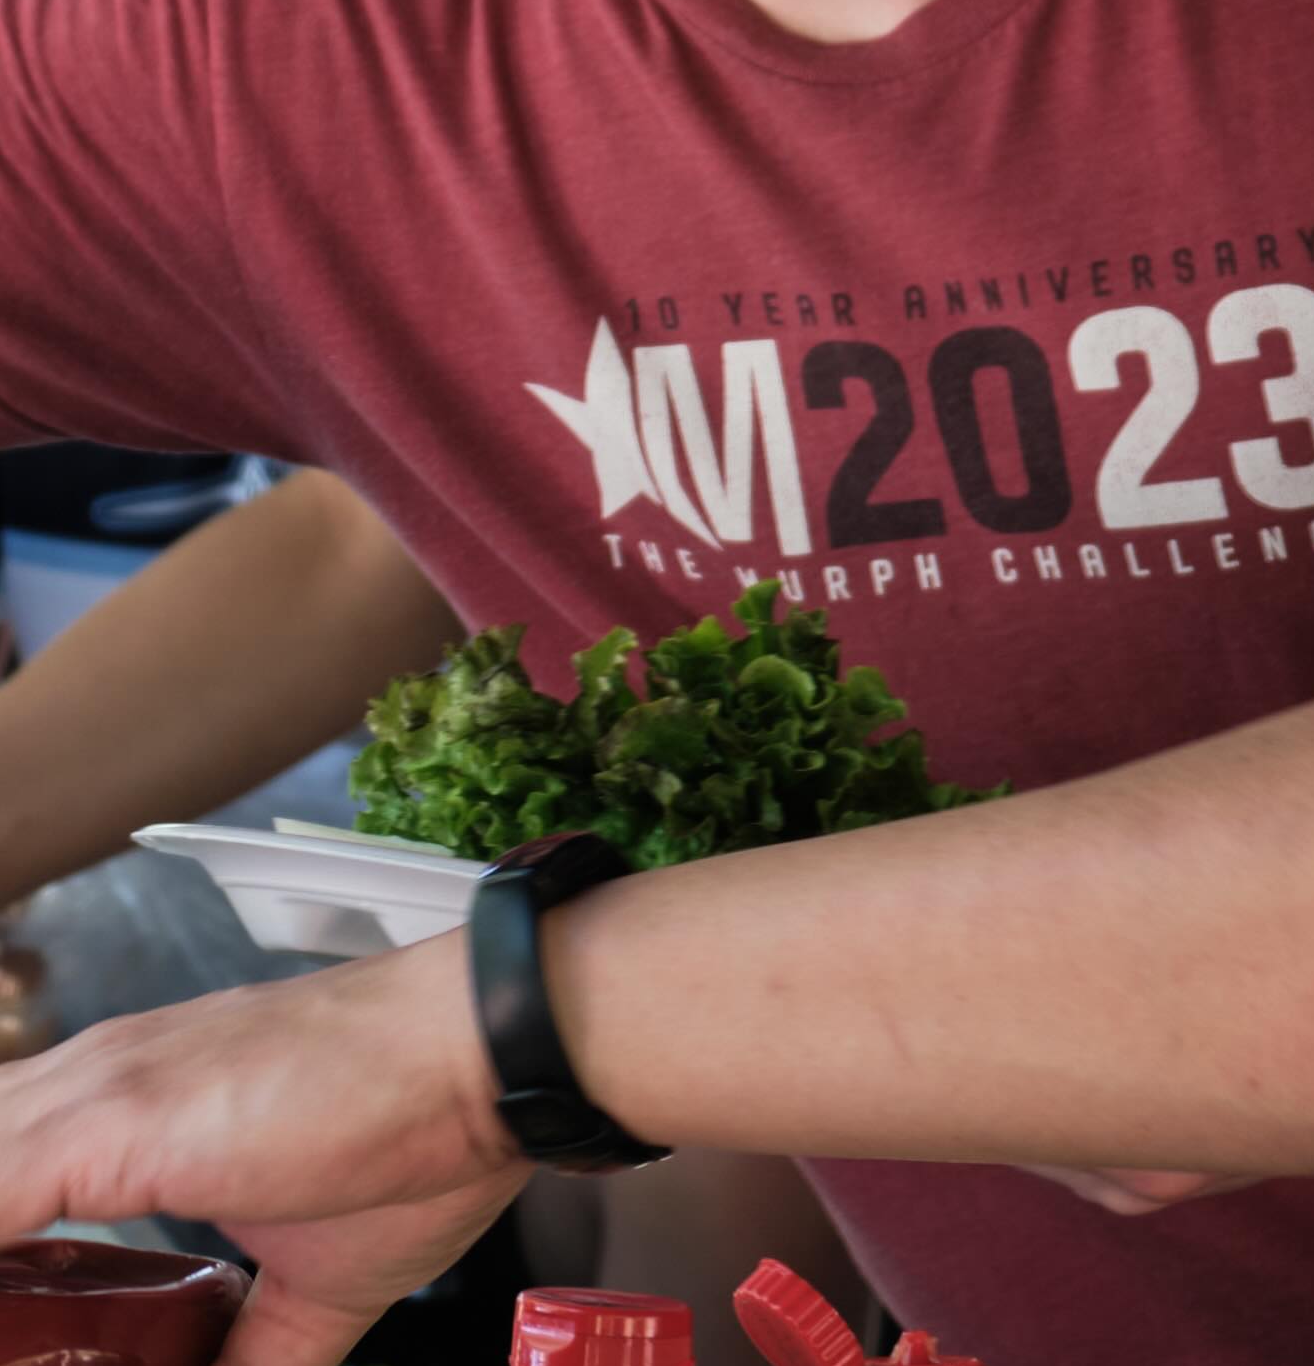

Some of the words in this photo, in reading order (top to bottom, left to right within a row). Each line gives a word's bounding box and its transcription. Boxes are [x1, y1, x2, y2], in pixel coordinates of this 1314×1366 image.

[625, 294, 681, 334] 10
[721, 290, 857, 328] YEAR
[603, 531, 704, 582] THE
